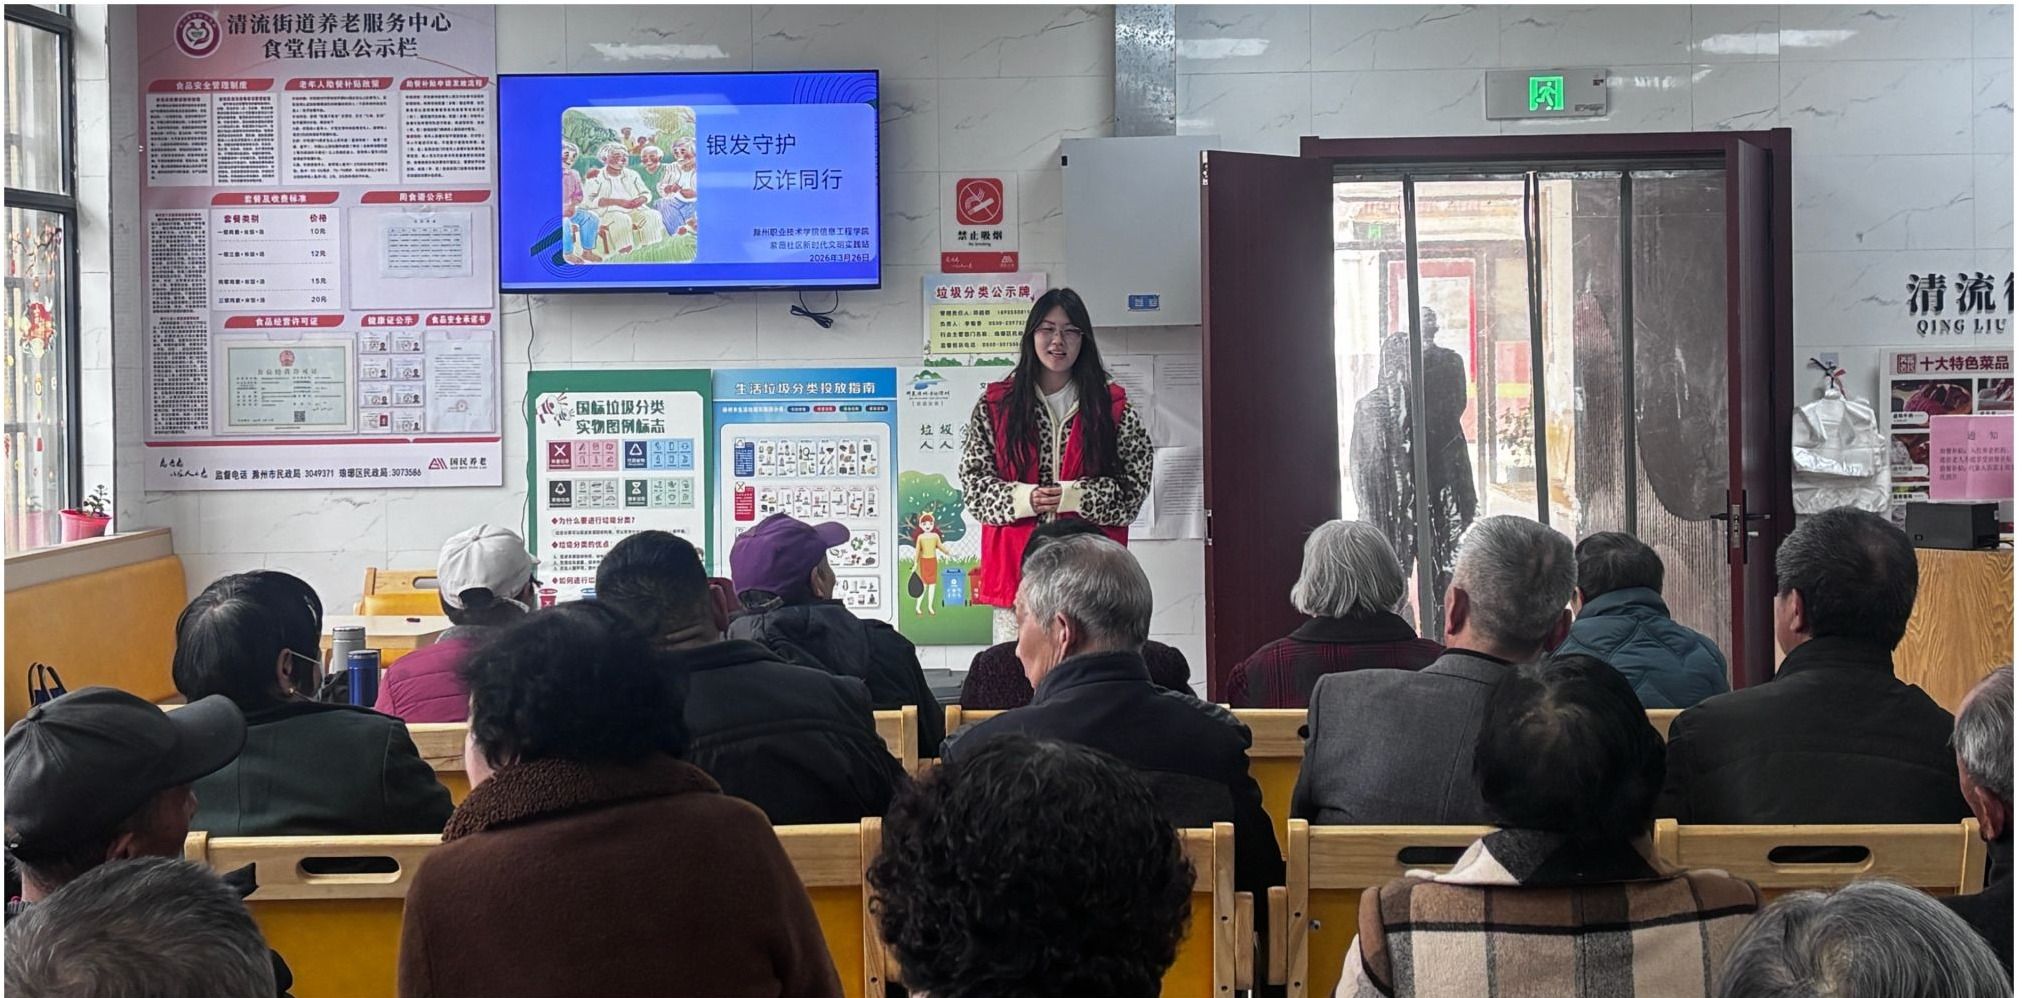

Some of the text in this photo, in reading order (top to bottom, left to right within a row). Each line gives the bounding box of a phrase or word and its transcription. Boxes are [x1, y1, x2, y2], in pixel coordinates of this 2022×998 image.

[227, 12, 452, 34] 清流街道养老服务中心
[262, 38, 418, 59] 食堂信息公示栏
[176, 80, 248, 90] 食品安全管理制度
[299, 79, 380, 89] 老年人助餐补贴政策
[706, 133, 796, 155] 银发守护
[753, 169, 843, 190] 反诈同行
[244, 194, 307, 204] 套餐及收费标准
[400, 192, 453, 201] 周食谱公示栏
[224, 213, 327, 224] 套餐类别 价格
[753, 227, 869, 237] 滁州职业技术学院信息工程学院
[958, 230, 1002, 240] 禁止吸烟
[809, 253, 870, 262] 2026年3月26日
[311, 277, 327, 285] 15元
[936, 285, 1031, 299] 垃圾分类公示牌
[311, 295, 327, 303] 20元
[256, 317, 318, 326] 食品经营许可证
[367, 316, 414, 325] 健康证公示
[431, 315, 486, 324] 食品安全承诺书
[1916, 318, 2006, 337] QING LIU
[1920, 355, 2010, 371] 十大特色菜品
[735, 382, 875, 394] 生活垃圾分类投放指南
[576, 399, 665, 415] 国标垃圾分类
[576, 418, 665, 434] 实物图例标志
[450, 457, 487, 466] 国民养老
[215, 470, 248, 480] 监督电话
[252, 468, 301, 480] 滁州市民政局
[305, 469, 334, 478] 3049371
[559, 516, 636, 525] 为什么要进行垃圾分类?
